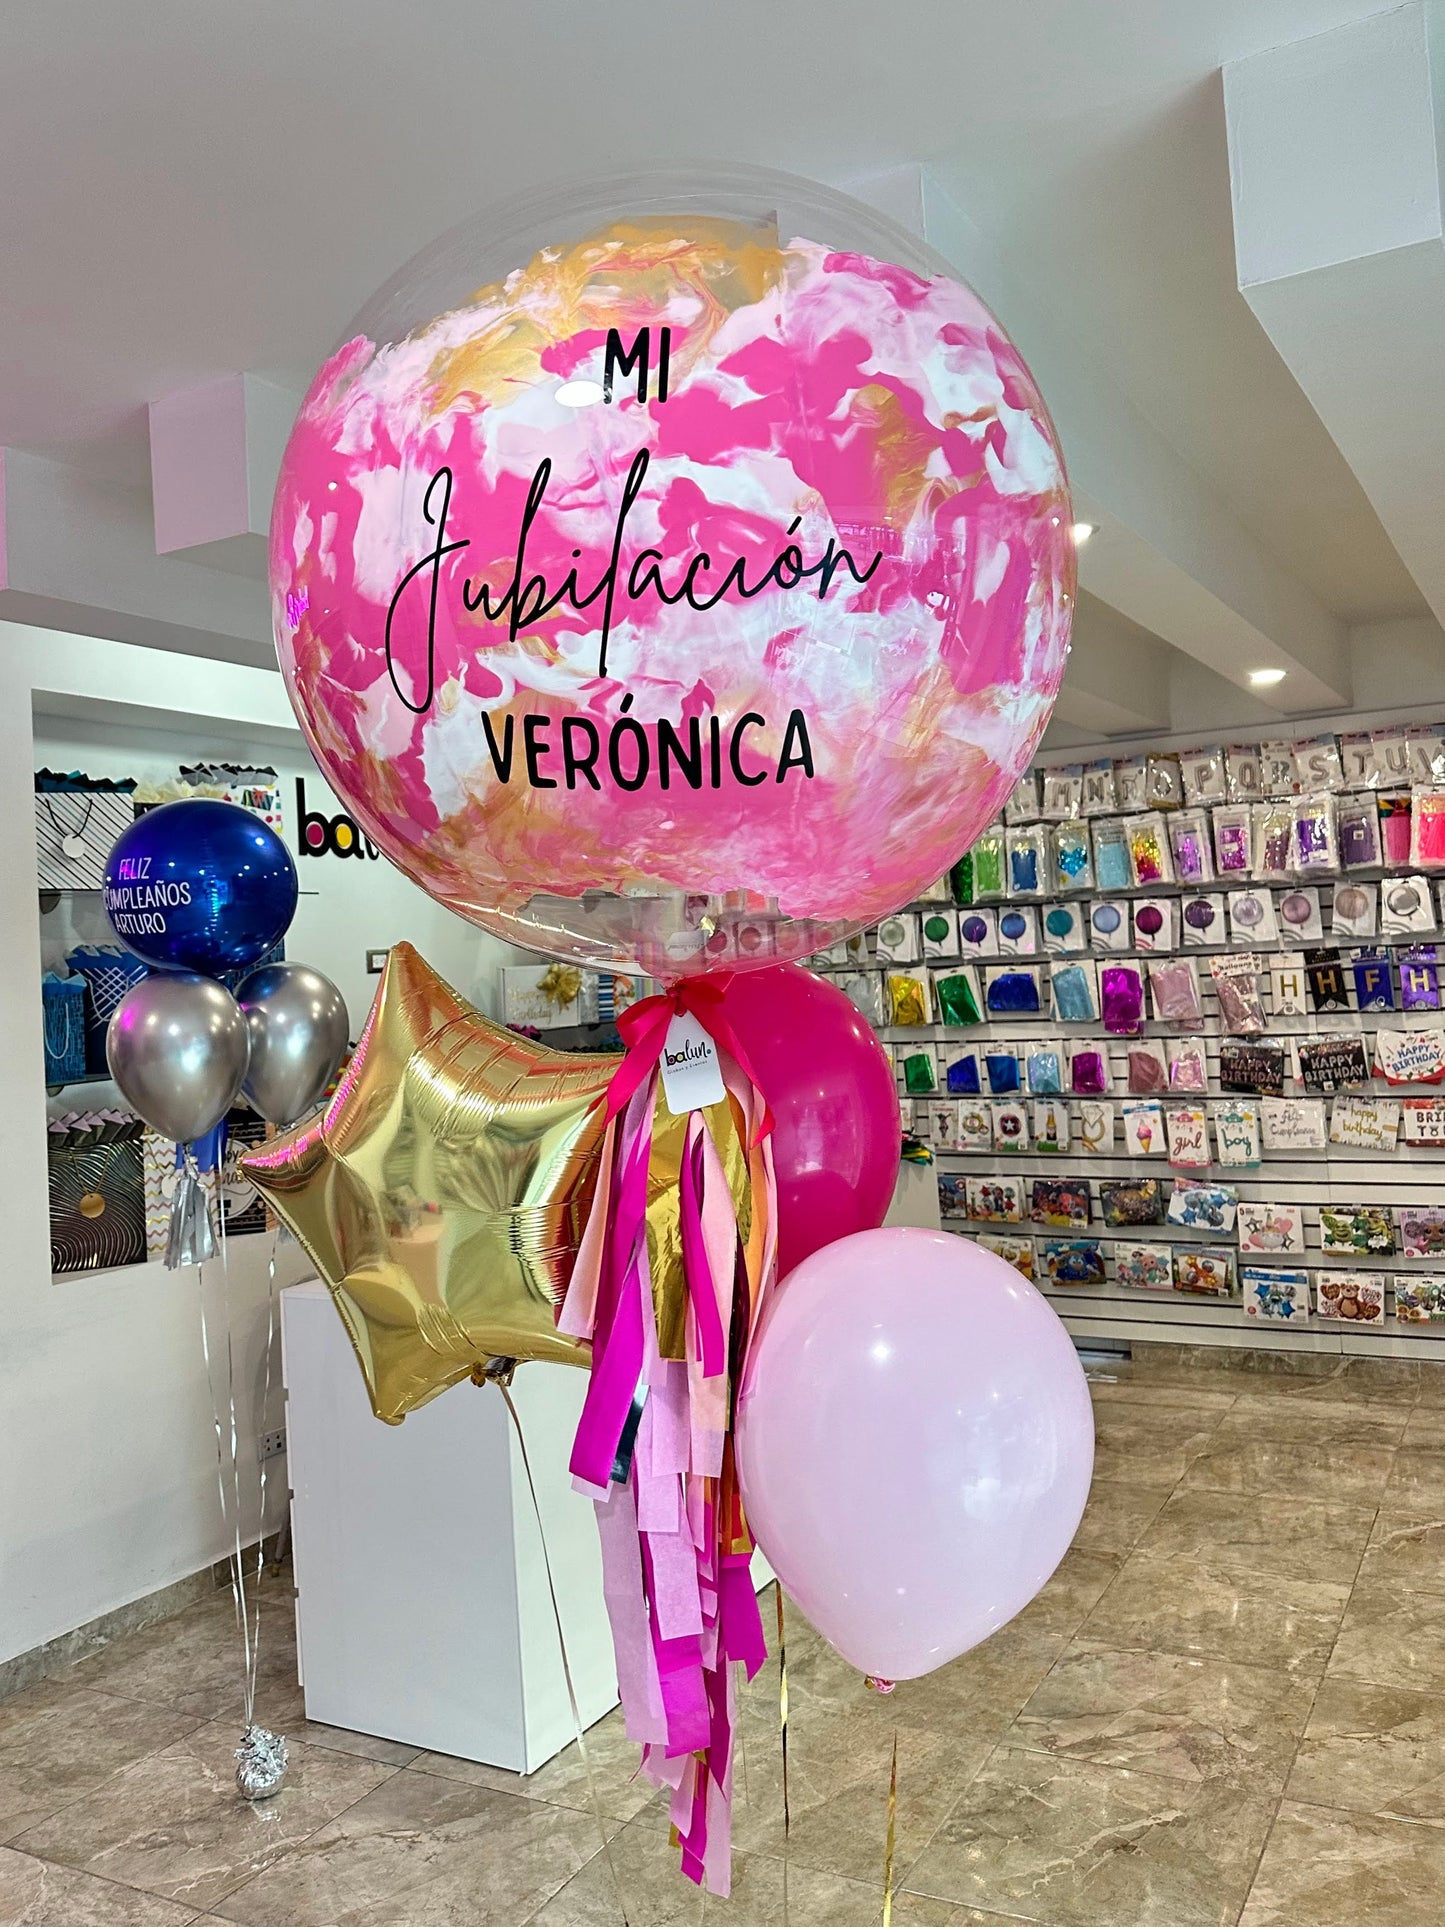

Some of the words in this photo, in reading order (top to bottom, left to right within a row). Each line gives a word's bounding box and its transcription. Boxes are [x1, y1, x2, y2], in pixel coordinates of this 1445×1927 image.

[604, 327, 671, 404] MI
[385, 448, 882, 713] Jubilación
[481, 693, 814, 792] VERÓNICA
[1309, 755, 1330, 782] S
[1352, 748, 1374, 775] T
[1386, 746, 1406, 774] U
[1087, 776, 1105, 804] N
[1194, 764, 1214, 794] P
[1052, 782, 1072, 808] M
[296, 777, 380, 860] ba
[119, 857, 152, 880] FELIZ
[103, 880, 191, 910] CUMPLEAÑOS
[114, 912, 166, 934] ARTURO
[1280, 974, 1298, 997] H
[1316, 969, 1337, 994] H
[1364, 969, 1380, 993] F
[1409, 968, 1430, 993] H
[1230, 1059, 1272, 1069] HAPPY
[1311, 1053, 1354, 1069] HAPPY
[1391, 1050, 1441, 1072] BIRTHDAY
[1397, 1044, 1430, 1059] HAPPY
[1221, 1069, 1282, 1084] BIRTHDAY
[1305, 1064, 1366, 1082] BIRTHDAY
[1351, 1104, 1378, 1122] happy
[1416, 1111, 1445, 1124] BRI
[1221, 1128, 1251, 1156] boy
[1343, 1119, 1383, 1141] birthday
[1173, 1131, 1202, 1156] girl
